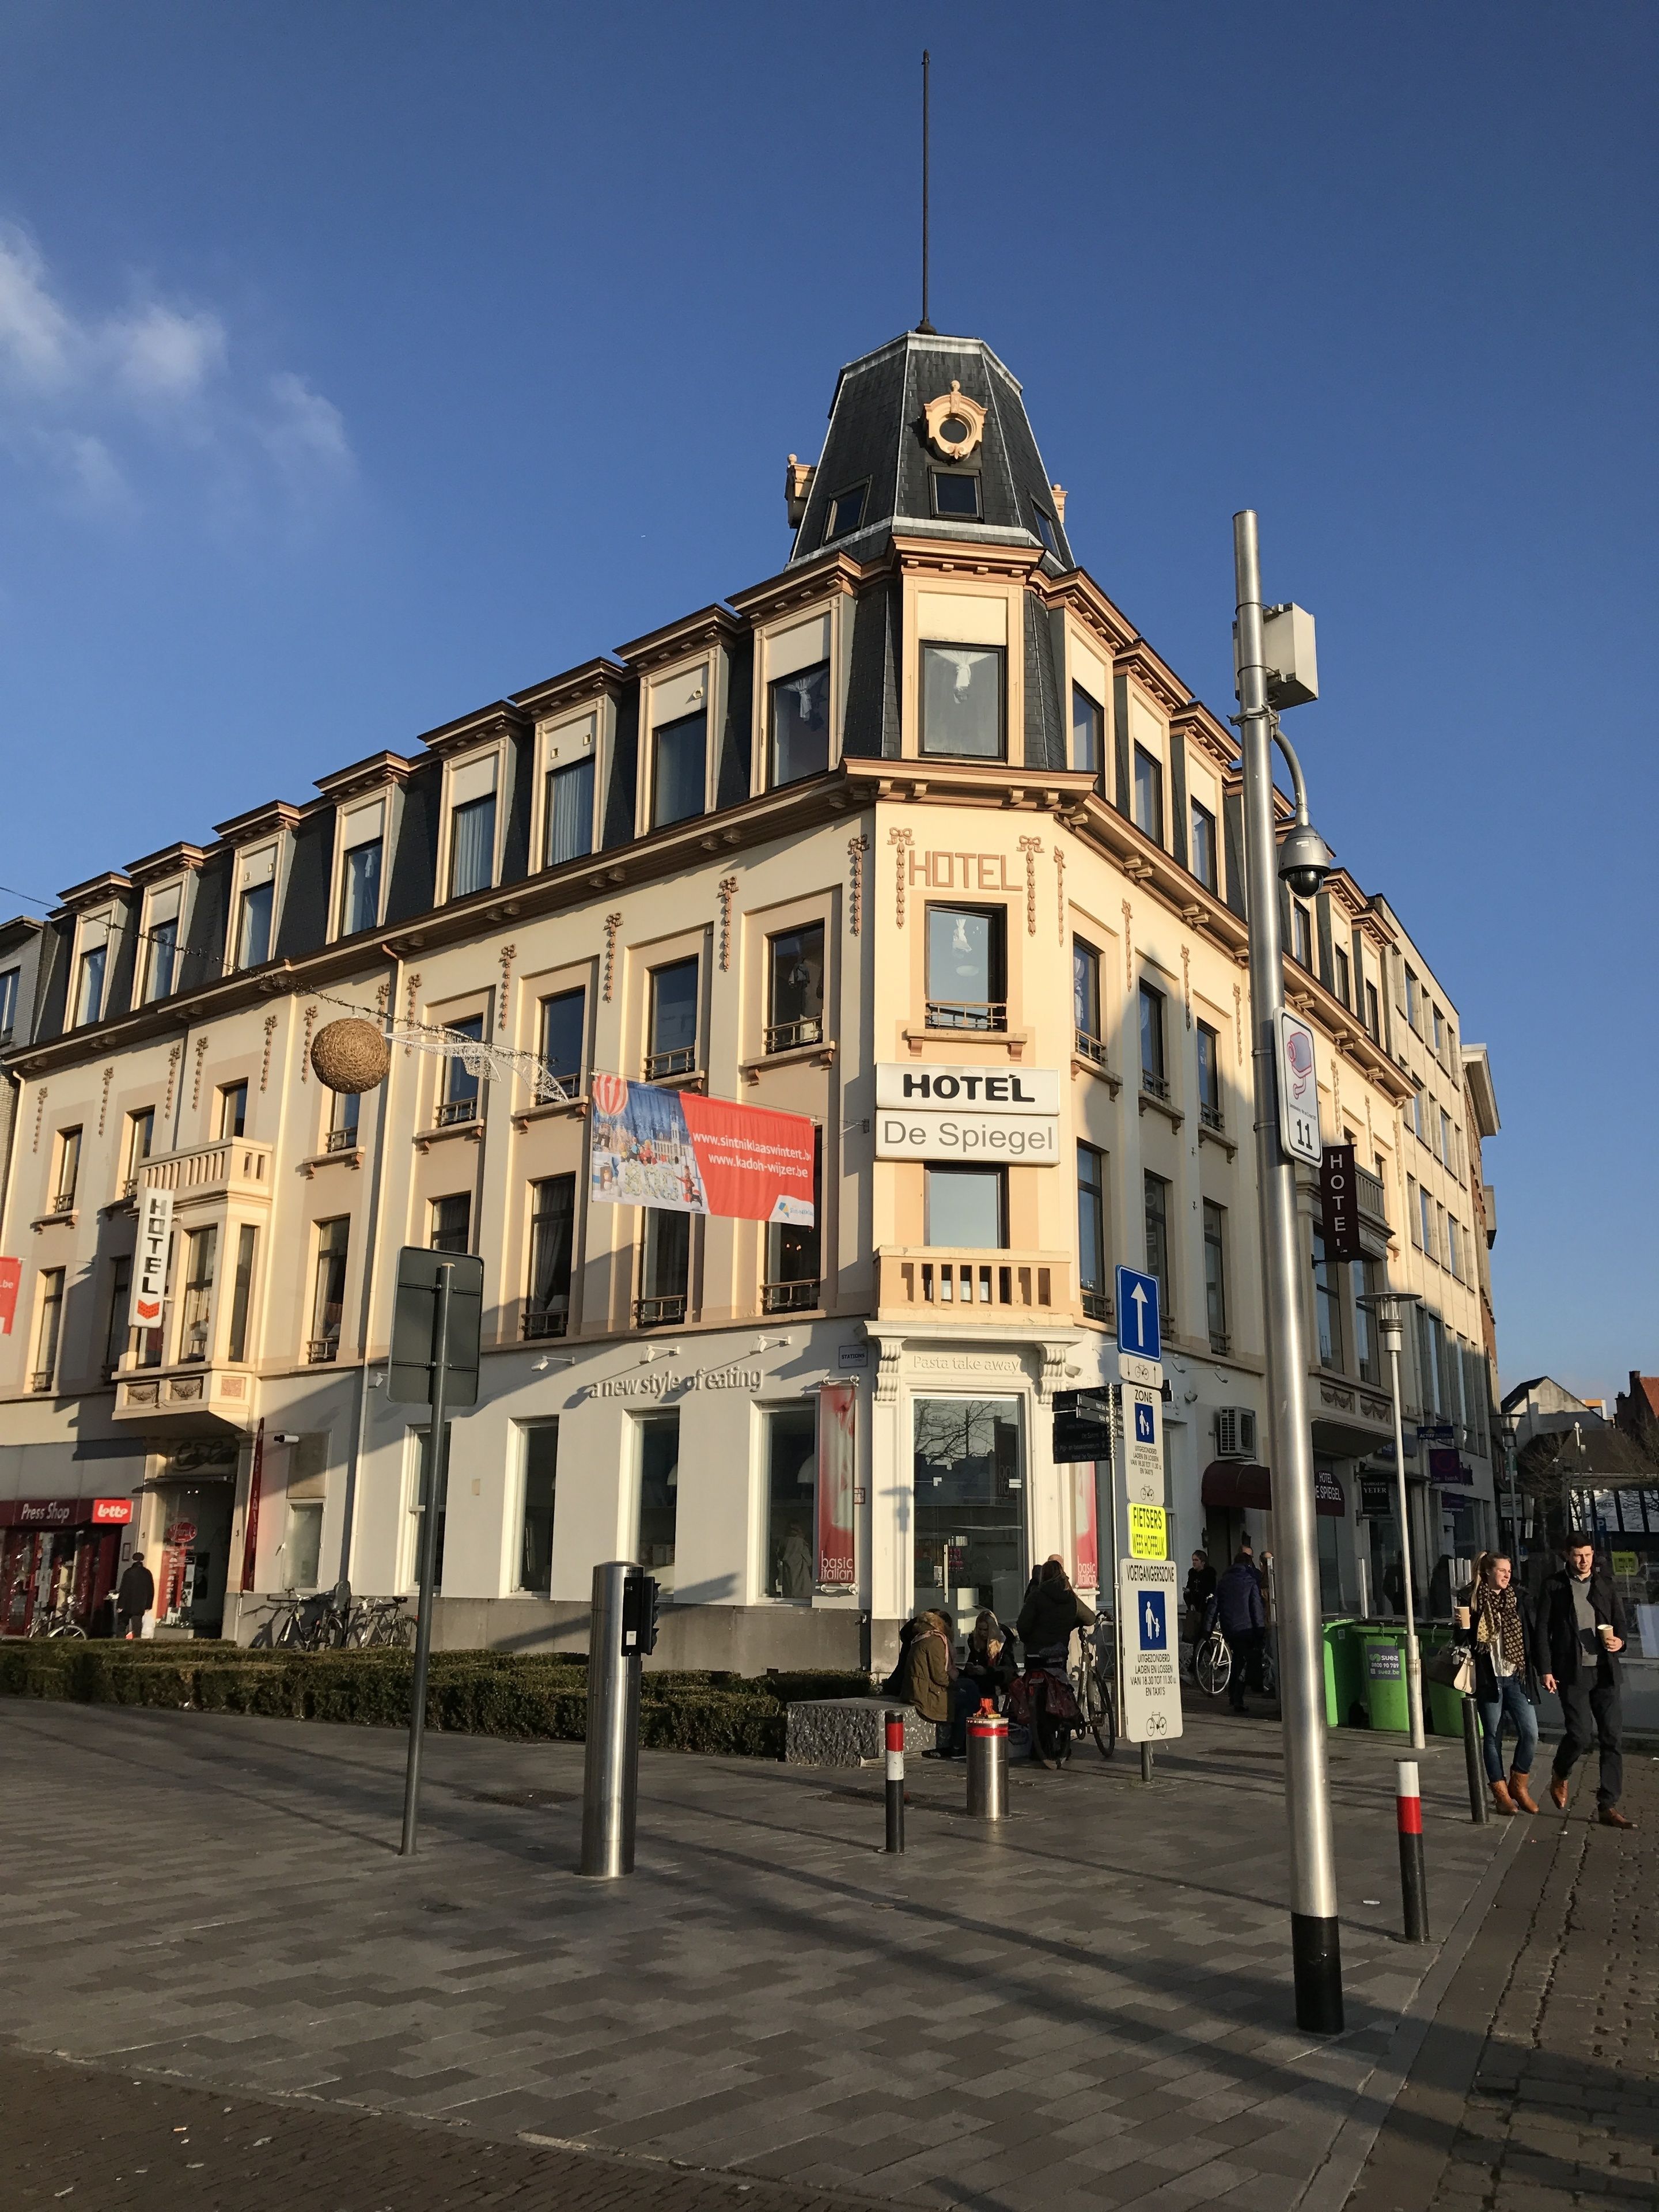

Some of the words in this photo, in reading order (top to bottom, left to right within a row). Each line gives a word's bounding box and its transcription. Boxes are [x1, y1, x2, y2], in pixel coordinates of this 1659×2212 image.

[910, 850, 1023, 891] HOTEL
[903, 1073, 1035, 1103] HOTEL
[884, 1120, 927, 1145] De
[938, 1122, 1052, 1154] Spiegel
[1297, 1119, 1313, 1151] 11
[708, 1153, 808, 1178] www.kadoh-wijzer.be
[1330, 1154, 1348, 1253] HOTEL
[142, 1198, 167, 1294] HOTEL
[914, 1355, 949, 1369] Pasta
[952, 1356, 982, 1370] take
[984, 1360, 1019, 1374] away
[588, 1382, 600, 1399] a
[603, 1378, 639, 1396] new
[640, 1370, 681, 1399] style
[685, 1367, 706, 1391] of
[705, 1365, 763, 1393] eating
[1135, 1389, 1153, 1403] ZONE
[1319, 1472, 1333, 1484] HOTEL
[1320, 1485, 1342, 1501] SPIEGEL
[21, 1502, 45, 1520] Press
[47, 1501, 70, 1524] Shop
[1133, 1506, 1162, 1530] FIETSERS
[1597, 1520, 1605, 1531] P
[1132, 1533, 1143, 1555] WEES
[821, 1550, 853, 1569] basic
[1077, 1556, 1096, 1574] basic
[821, 1567, 853, 1581] italian
[1078, 1573, 1097, 1585] italian
[1126, 1564, 1174, 1582] VOETGANGERSZONE
[1137, 1653, 1171, 1663] UITGEZONDERD
[1135, 1665, 1150, 1675] LADEN
[1151, 1665, 1157, 1673] EN
[1157, 1664, 1173, 1673] LOSSEN
[1130, 1676, 1141, 1685] VAN
[1142, 1676, 1154, 1685] 18.30
[1163, 1675, 1173, 1684] 11.30
[1145, 1687, 1152, 1696] EN
[1152, 1687, 1165, 1696] TAXI'S
